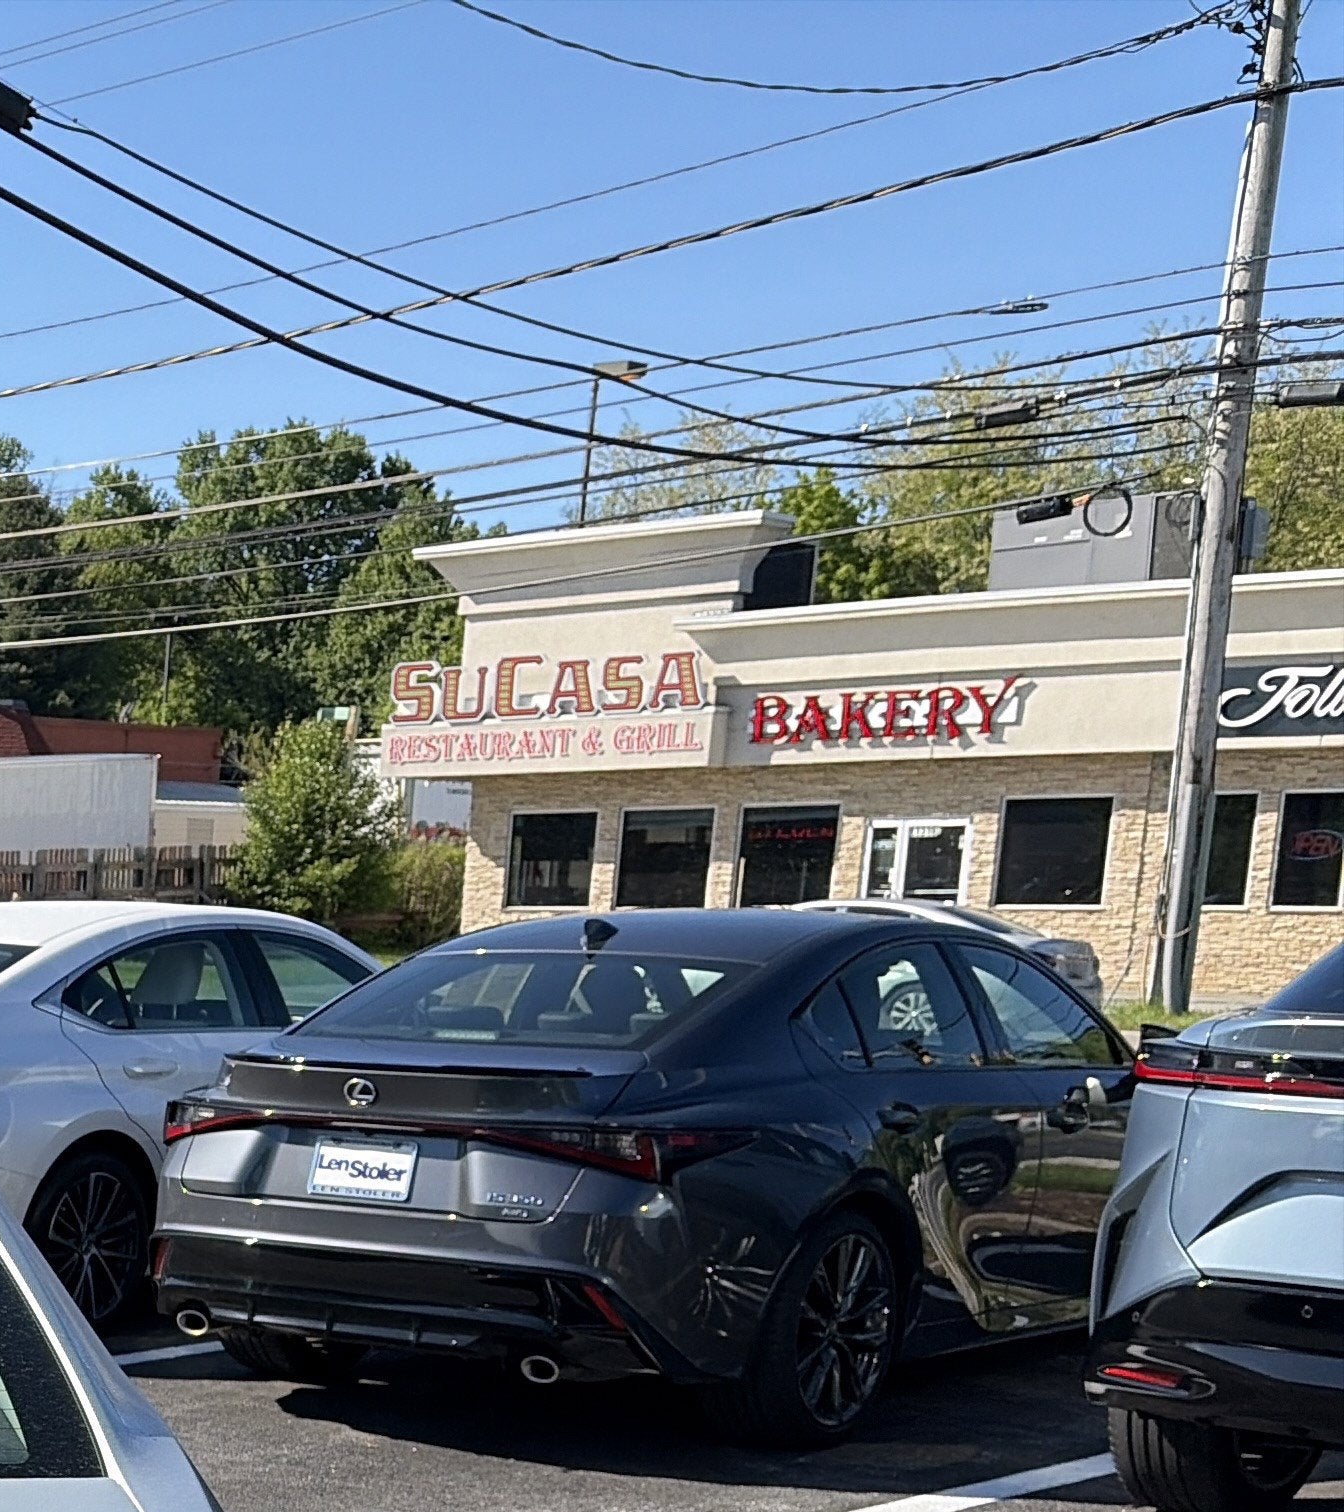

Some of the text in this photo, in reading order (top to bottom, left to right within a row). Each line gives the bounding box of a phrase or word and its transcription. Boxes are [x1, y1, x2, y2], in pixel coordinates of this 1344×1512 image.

[748, 673, 1024, 744] BAKERY
[387, 721, 704, 764] RESTAURANT & GRILL
